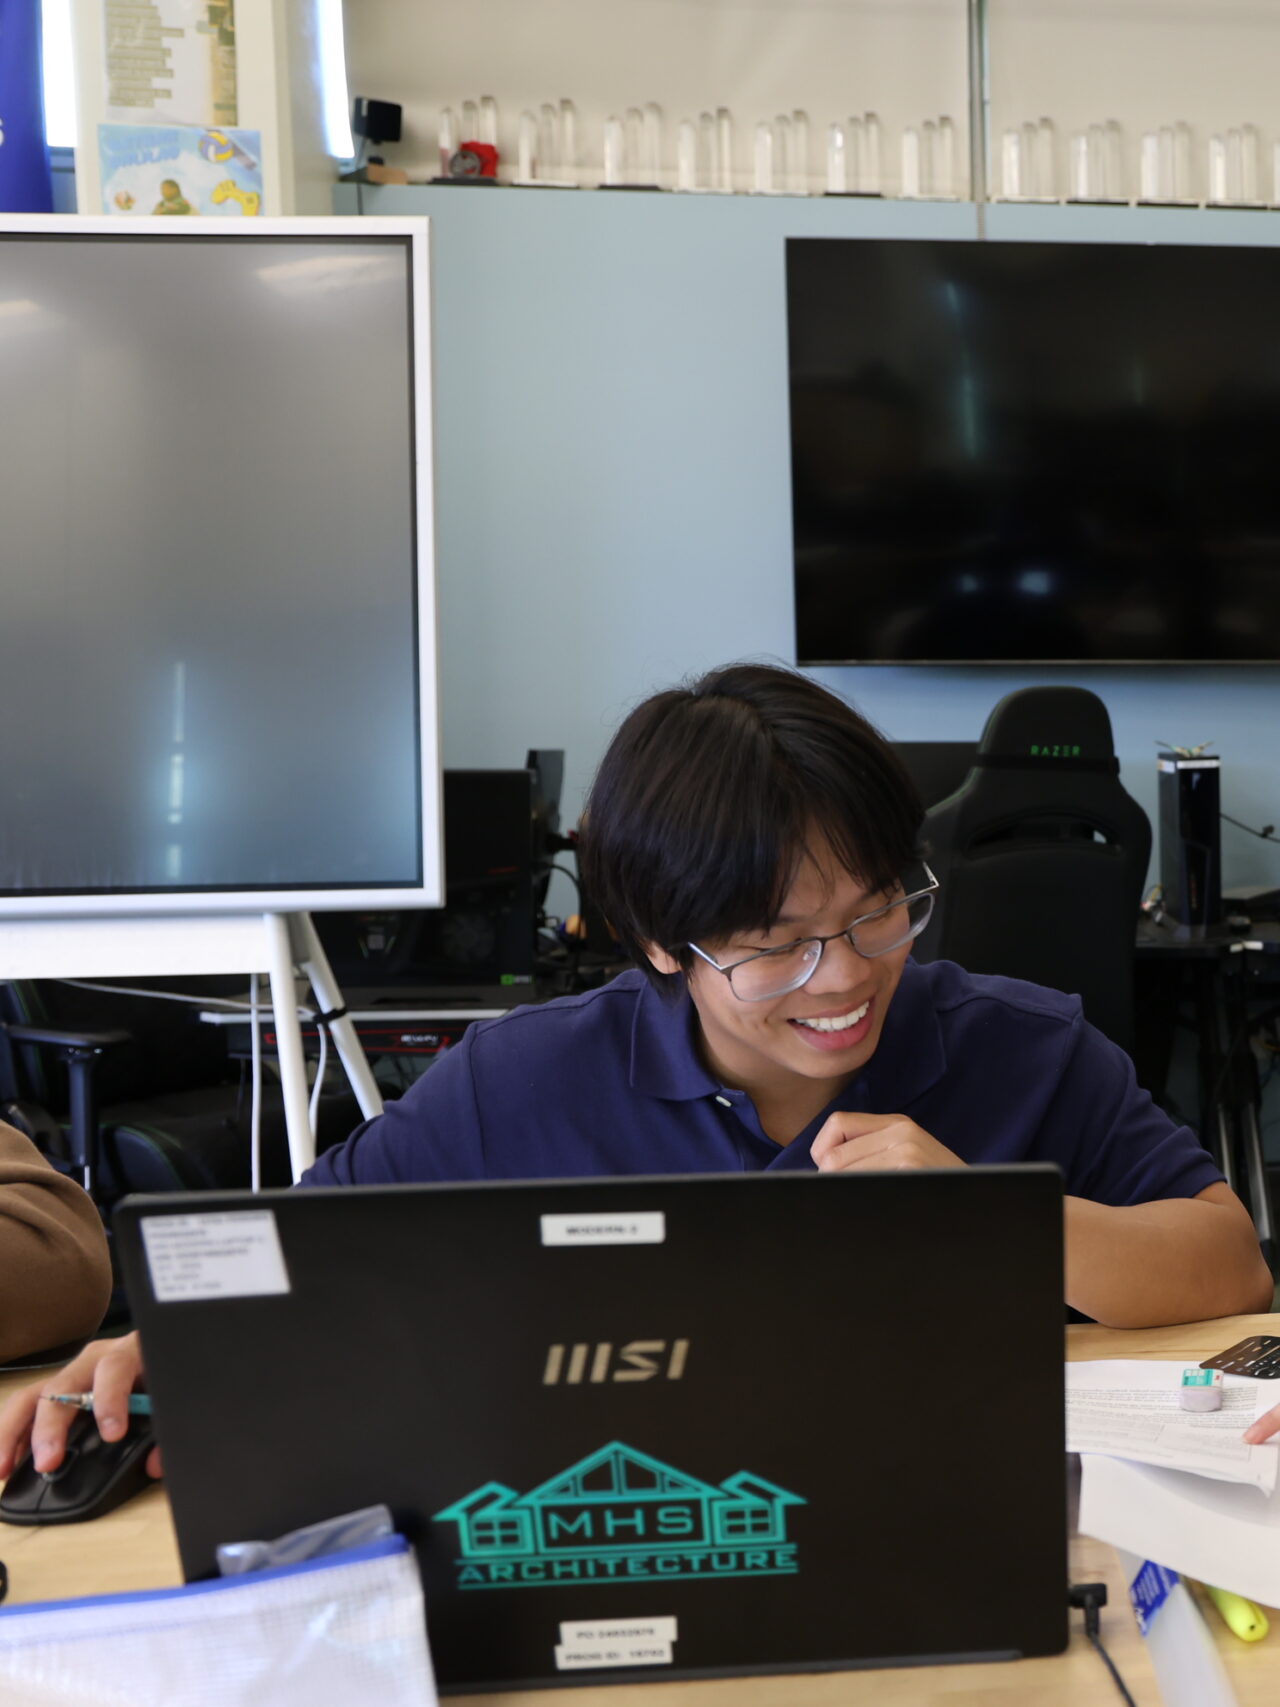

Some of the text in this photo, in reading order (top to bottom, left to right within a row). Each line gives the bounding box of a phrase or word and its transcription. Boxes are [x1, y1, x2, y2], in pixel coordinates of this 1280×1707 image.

[1030, 744, 1081, 757] RAZER
[549, 1506, 694, 1540] MHS
[457, 1550, 798, 1582] ARCHITECTURE
